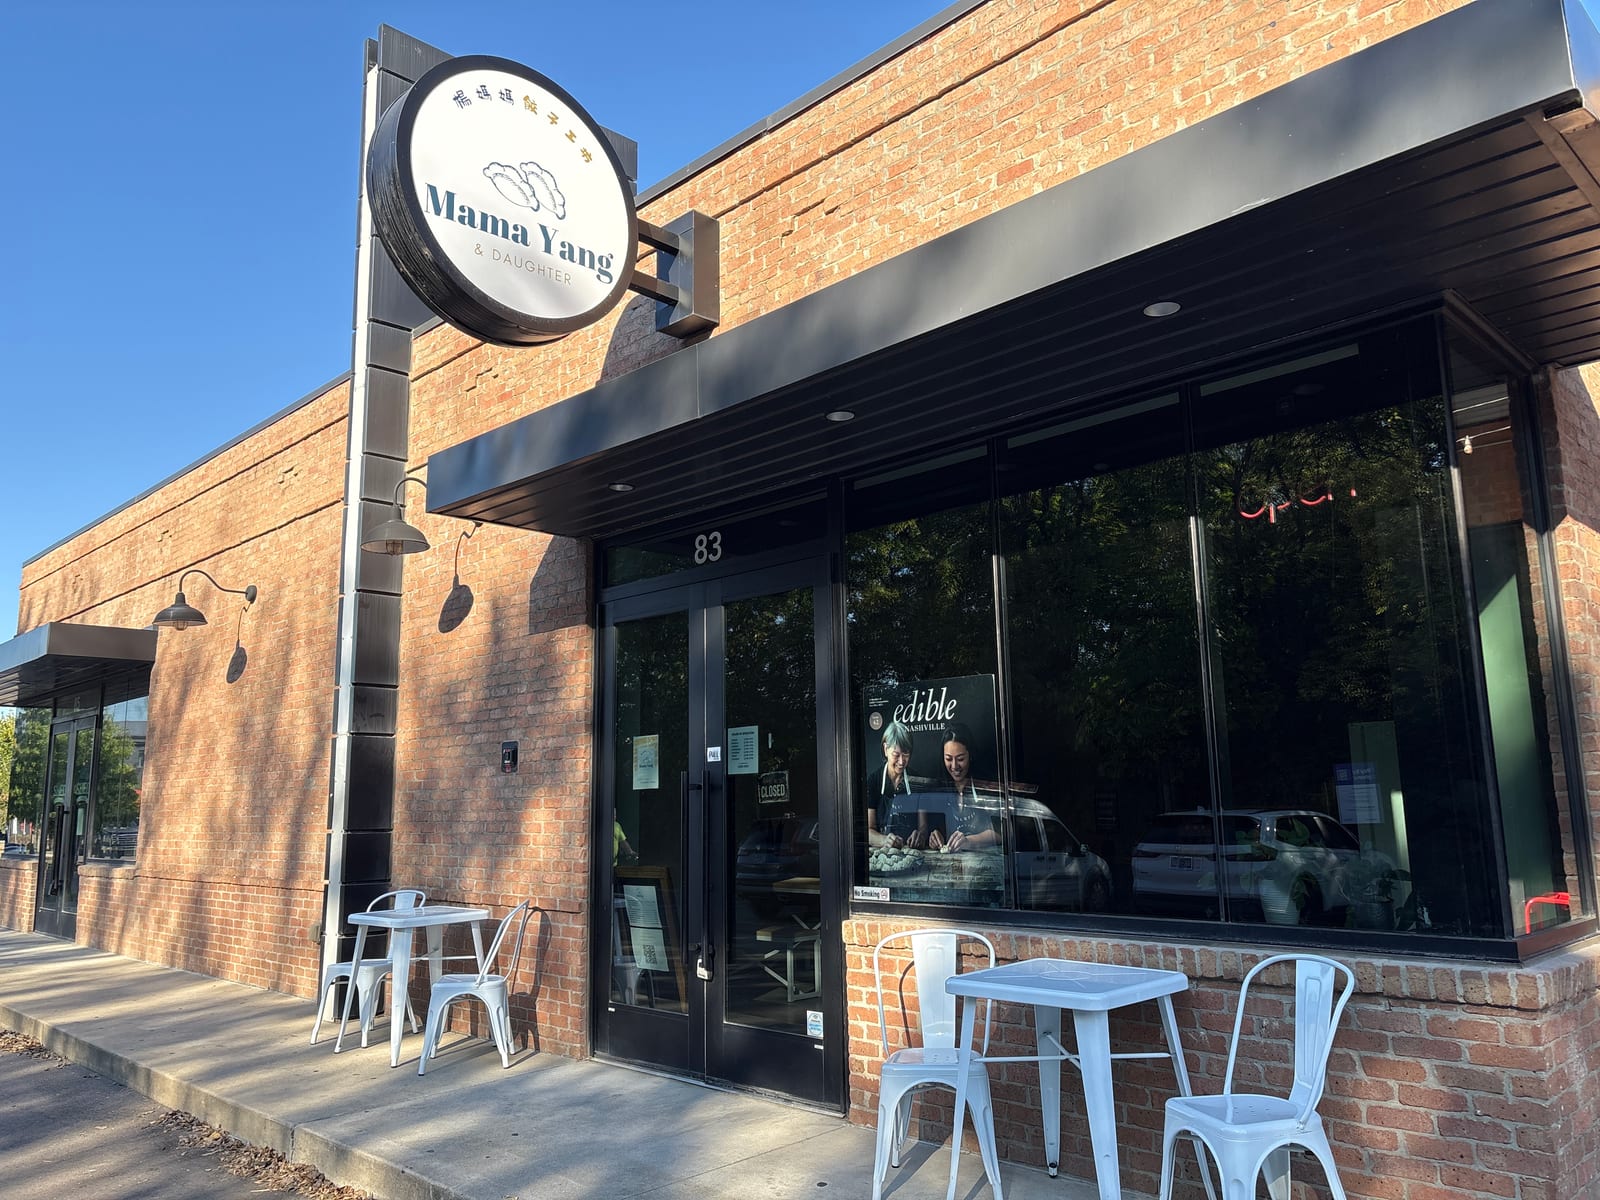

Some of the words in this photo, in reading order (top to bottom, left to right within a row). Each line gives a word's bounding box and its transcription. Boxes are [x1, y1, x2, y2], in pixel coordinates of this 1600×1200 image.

[424, 183, 530, 247] Mama
[537, 222, 613, 284] Yang
[474, 243, 484, 256] &
[492, 249, 571, 285] DAUGHTER
[694, 531, 722, 565] 83
[893, 687, 957, 723] edible
[904, 722, 946, 733] NASHVILLE
[761, 784, 785, 798] CLOSED
[862, 889, 880, 899] Smoking
